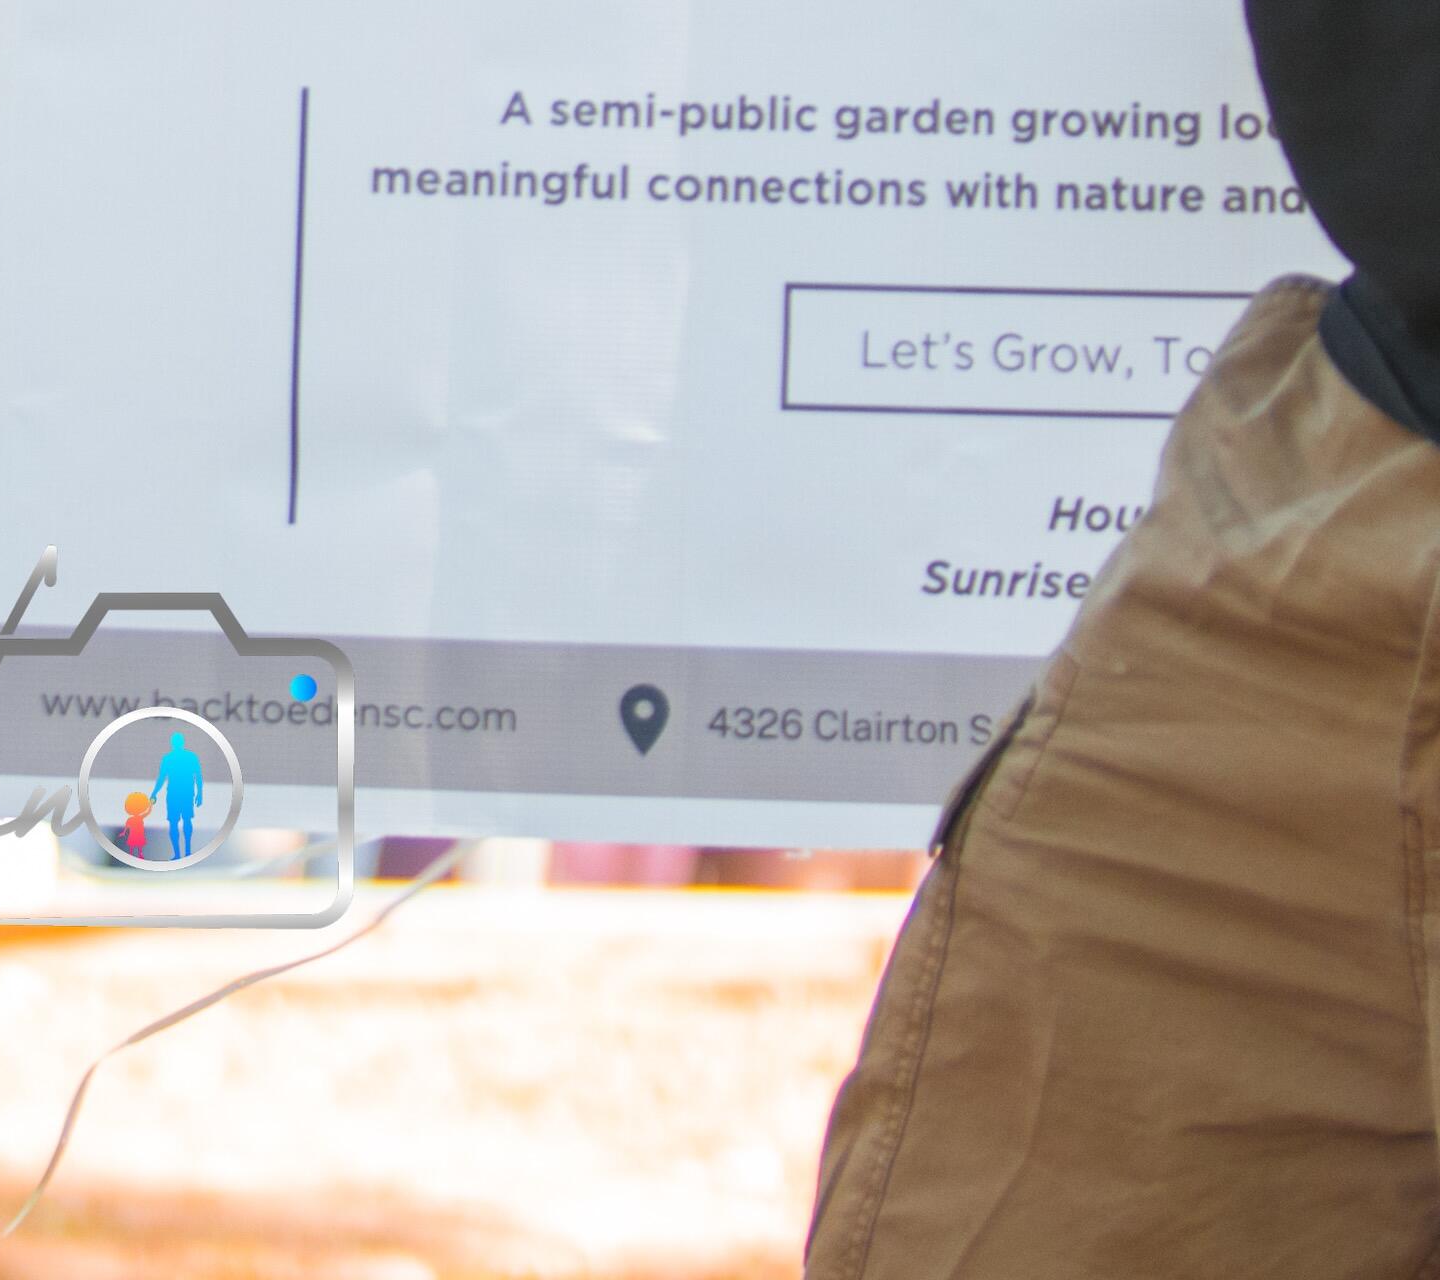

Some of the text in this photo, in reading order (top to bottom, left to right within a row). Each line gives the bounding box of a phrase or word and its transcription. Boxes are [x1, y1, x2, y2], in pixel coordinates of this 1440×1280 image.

[500, 91, 532, 126] A
[550, 93, 818, 138] semi-public
[834, 99, 996, 141] garden
[1010, 102, 1201, 147] growing
[370, 162, 630, 206] meaningful
[646, 169, 928, 208] connections
[945, 172, 1038, 210] with
[1056, 178, 1205, 214] nature
[861, 331, 975, 371] Let's
[991, 332, 1134, 380] Grow,
[921, 560, 1091, 599] Sunrise
[41, 688, 517, 734] wwwbacktoednsc.com
[706, 707, 804, 742] 4326
[812, 709, 959, 745] Clairton
